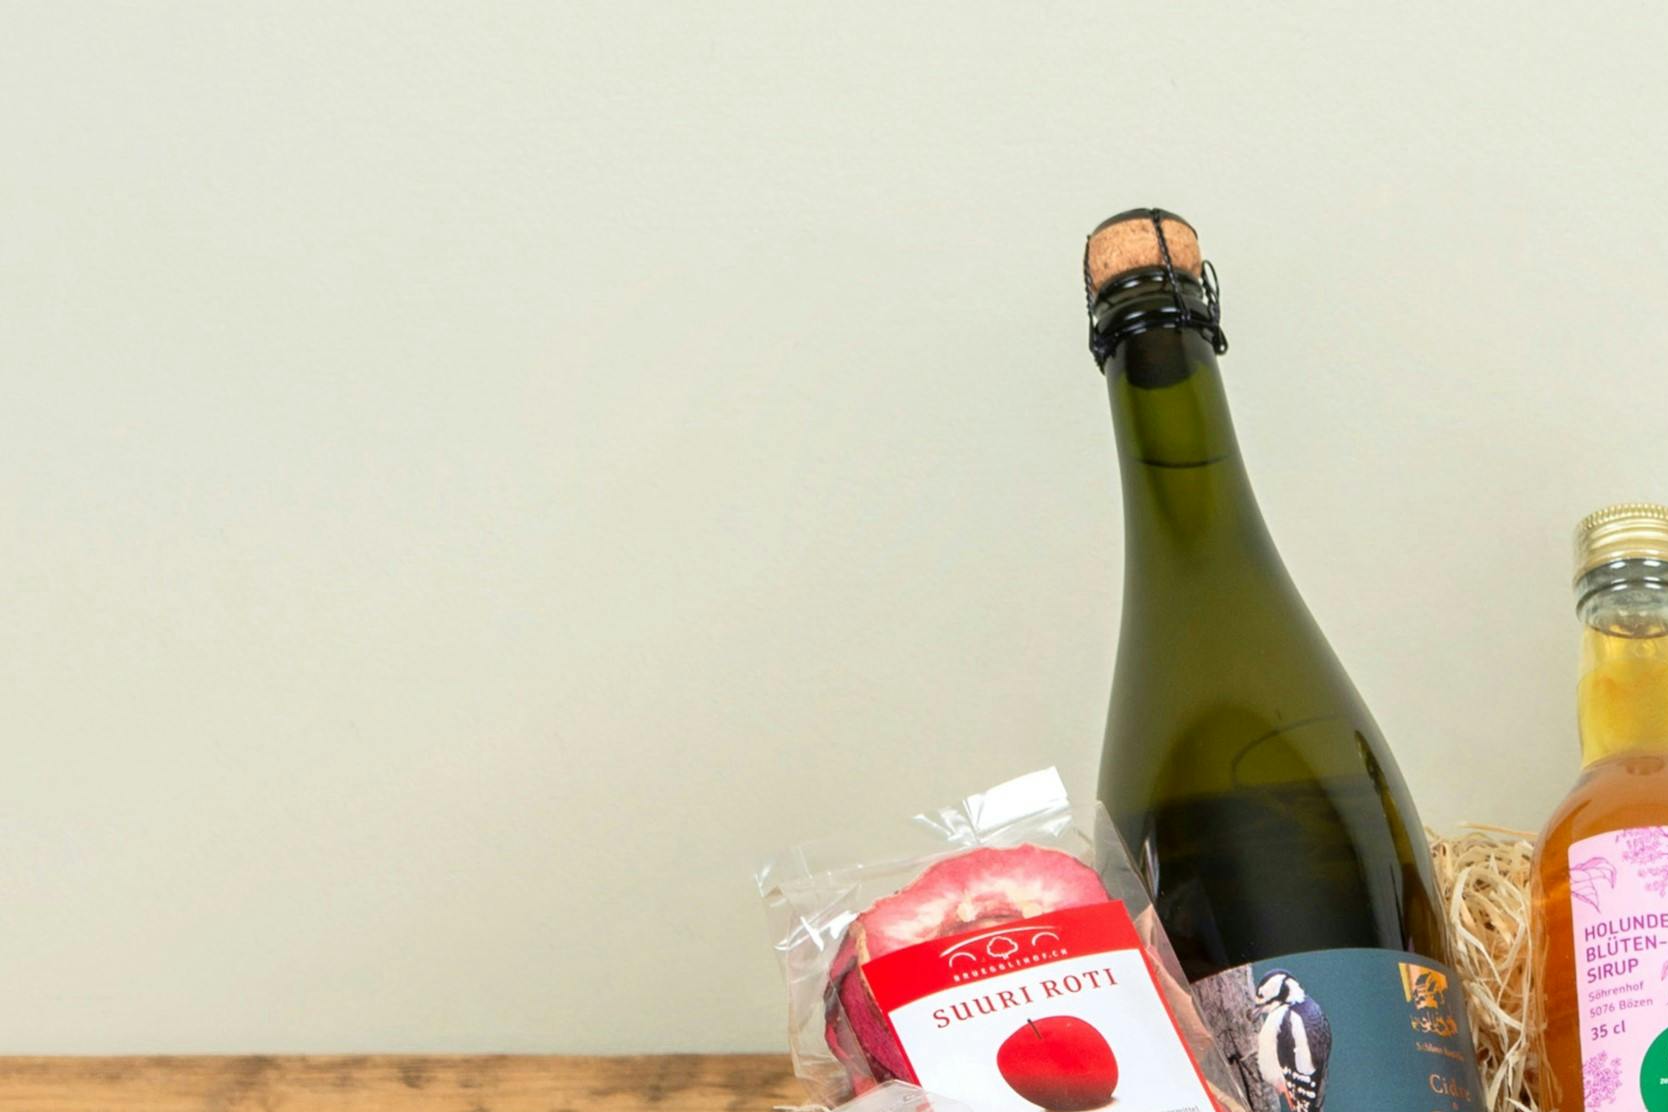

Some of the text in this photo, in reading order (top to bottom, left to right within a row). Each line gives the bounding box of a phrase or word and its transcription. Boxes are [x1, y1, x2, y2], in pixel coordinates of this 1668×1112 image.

[1586, 934, 1668, 963] BLÜTEN-
[953, 948, 1068, 982] BRUEGGLIHOF.CH
[1587, 958, 1639, 984] SIRUP
[932, 968, 1118, 1029] SUURI ROTI
[1588, 980, 1644, 1002] Söhrenhof
[1590, 998, 1654, 1018] 5076 Bözen
[1591, 1020, 1626, 1041] 35 cl
